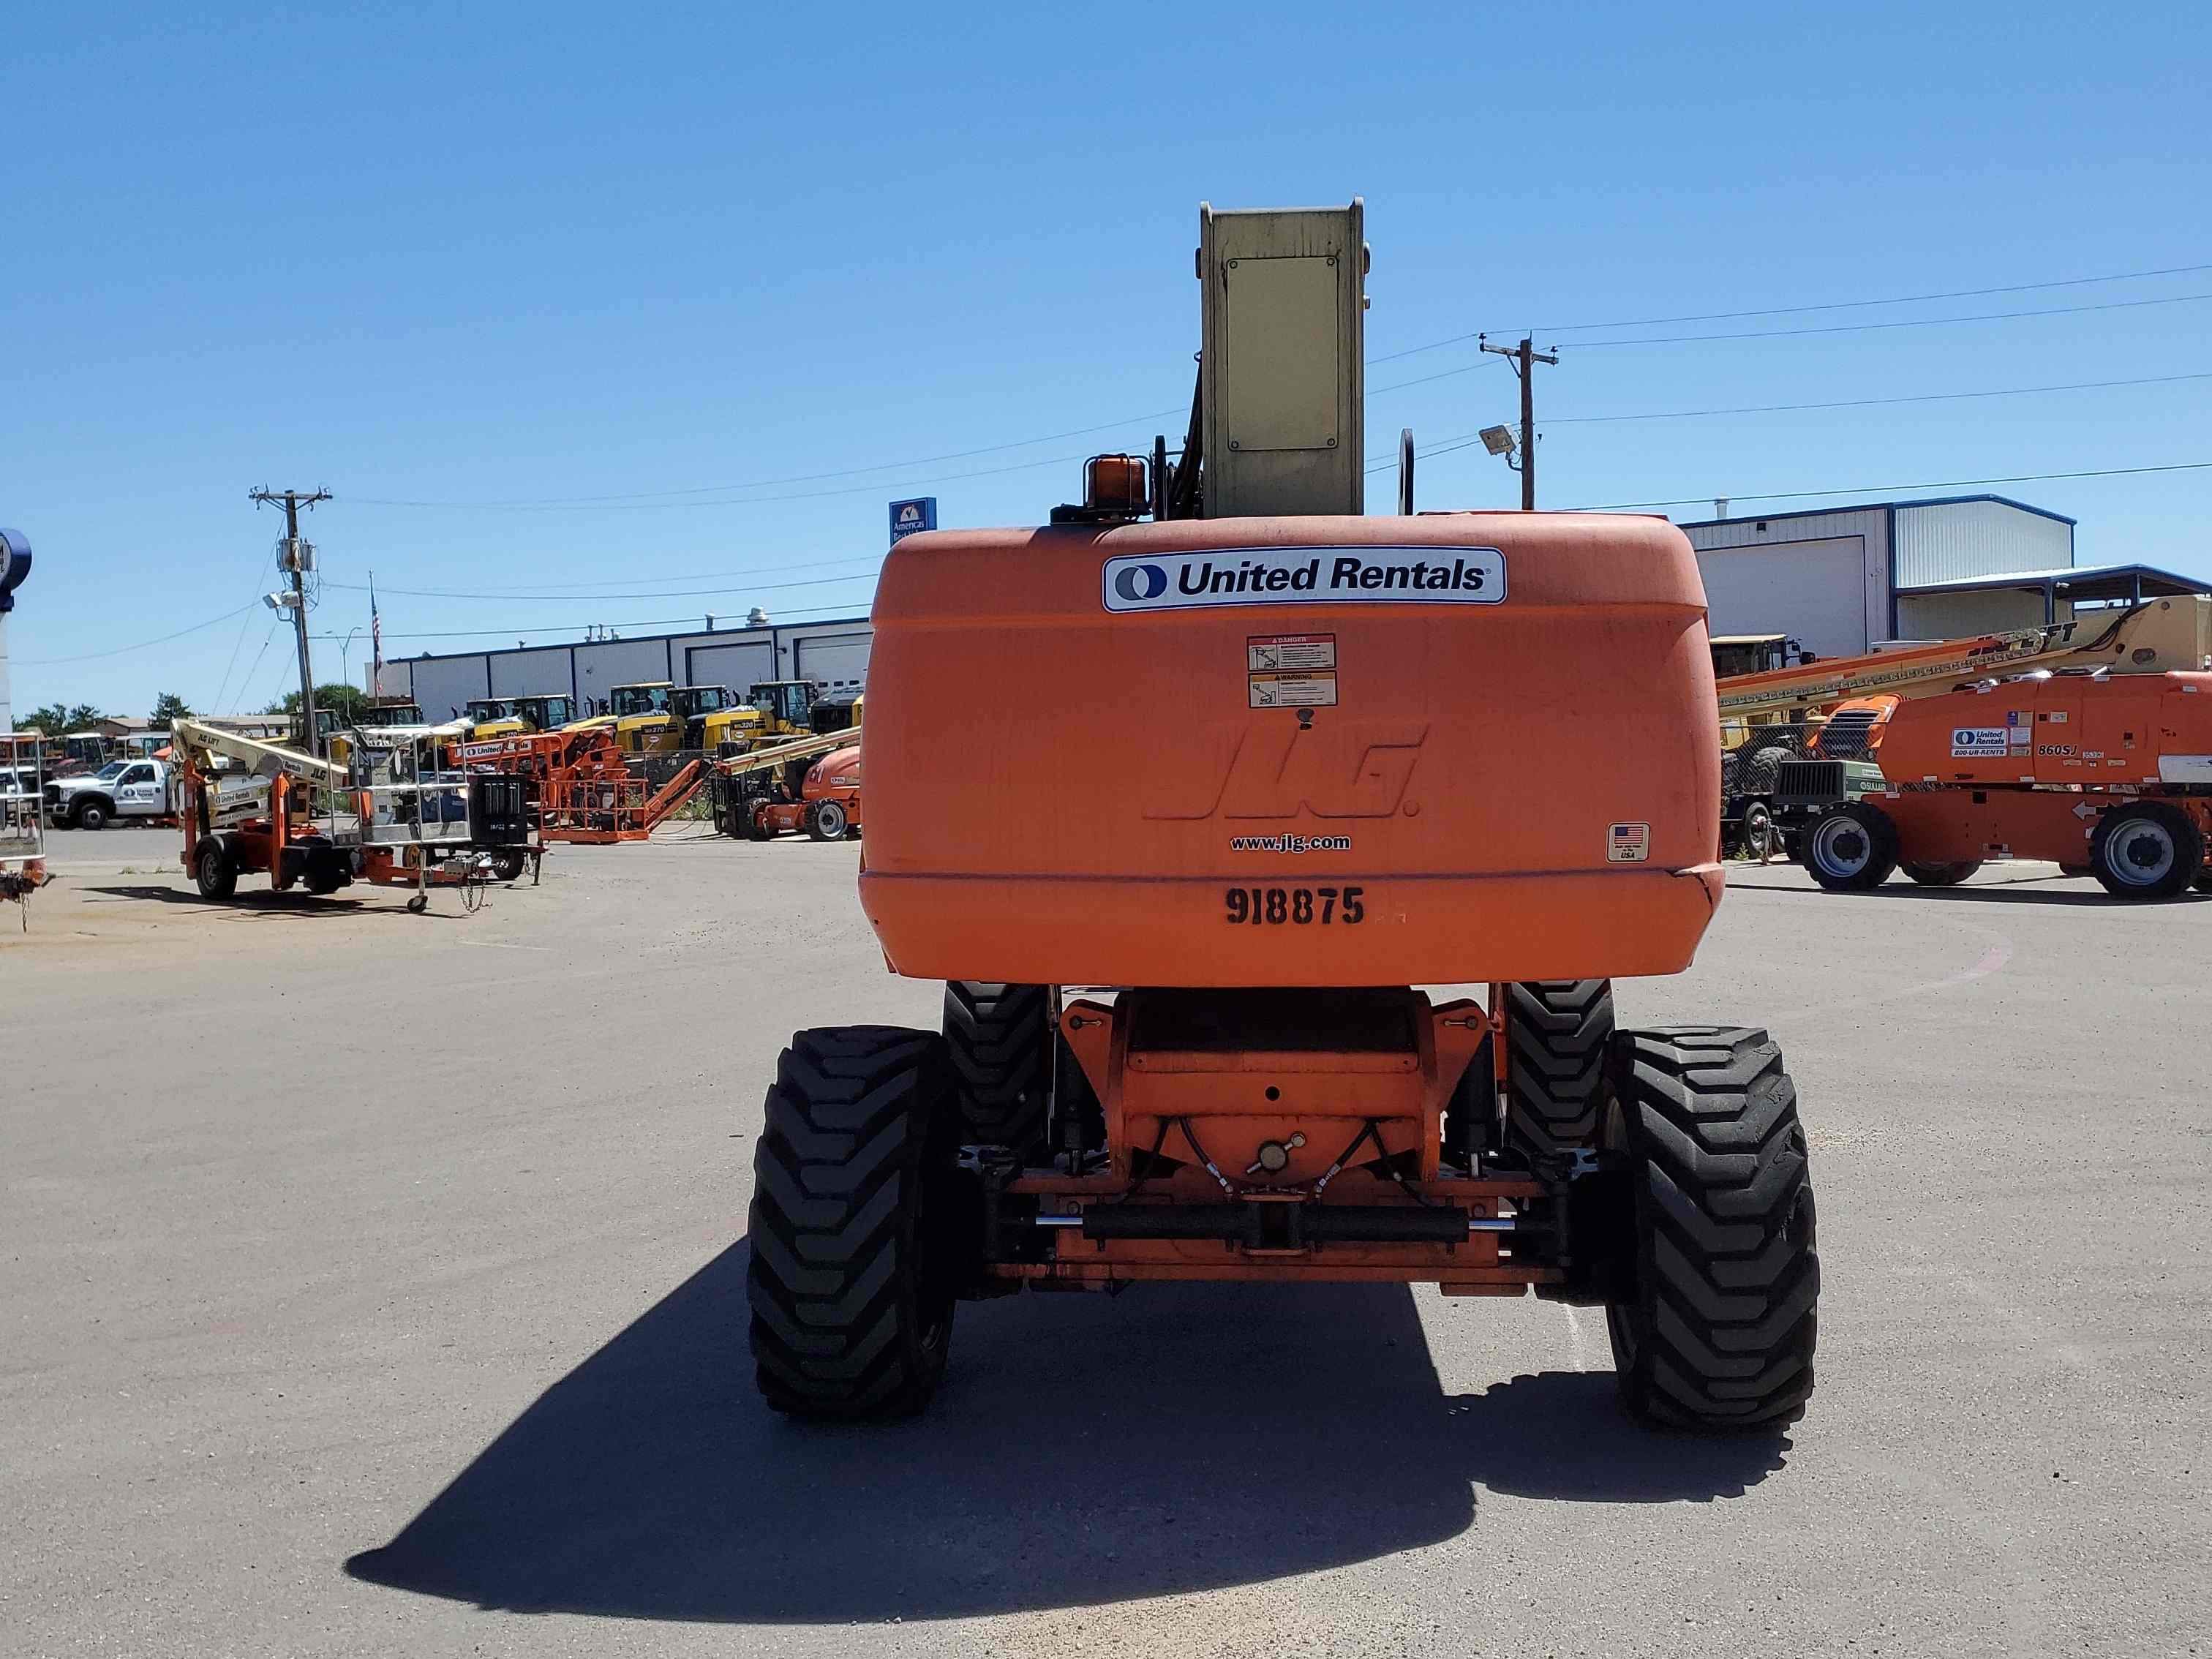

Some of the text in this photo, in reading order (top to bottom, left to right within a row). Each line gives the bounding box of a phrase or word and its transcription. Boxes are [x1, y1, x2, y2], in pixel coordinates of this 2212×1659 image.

[1178, 558, 1485, 595] United Rentals
[2037, 745, 2077, 756] 860SJ
[310, 768, 326, 781] JLG
[1230, 833, 1351, 854] www.jlg.com
[1226, 887, 1364, 925] 918875
